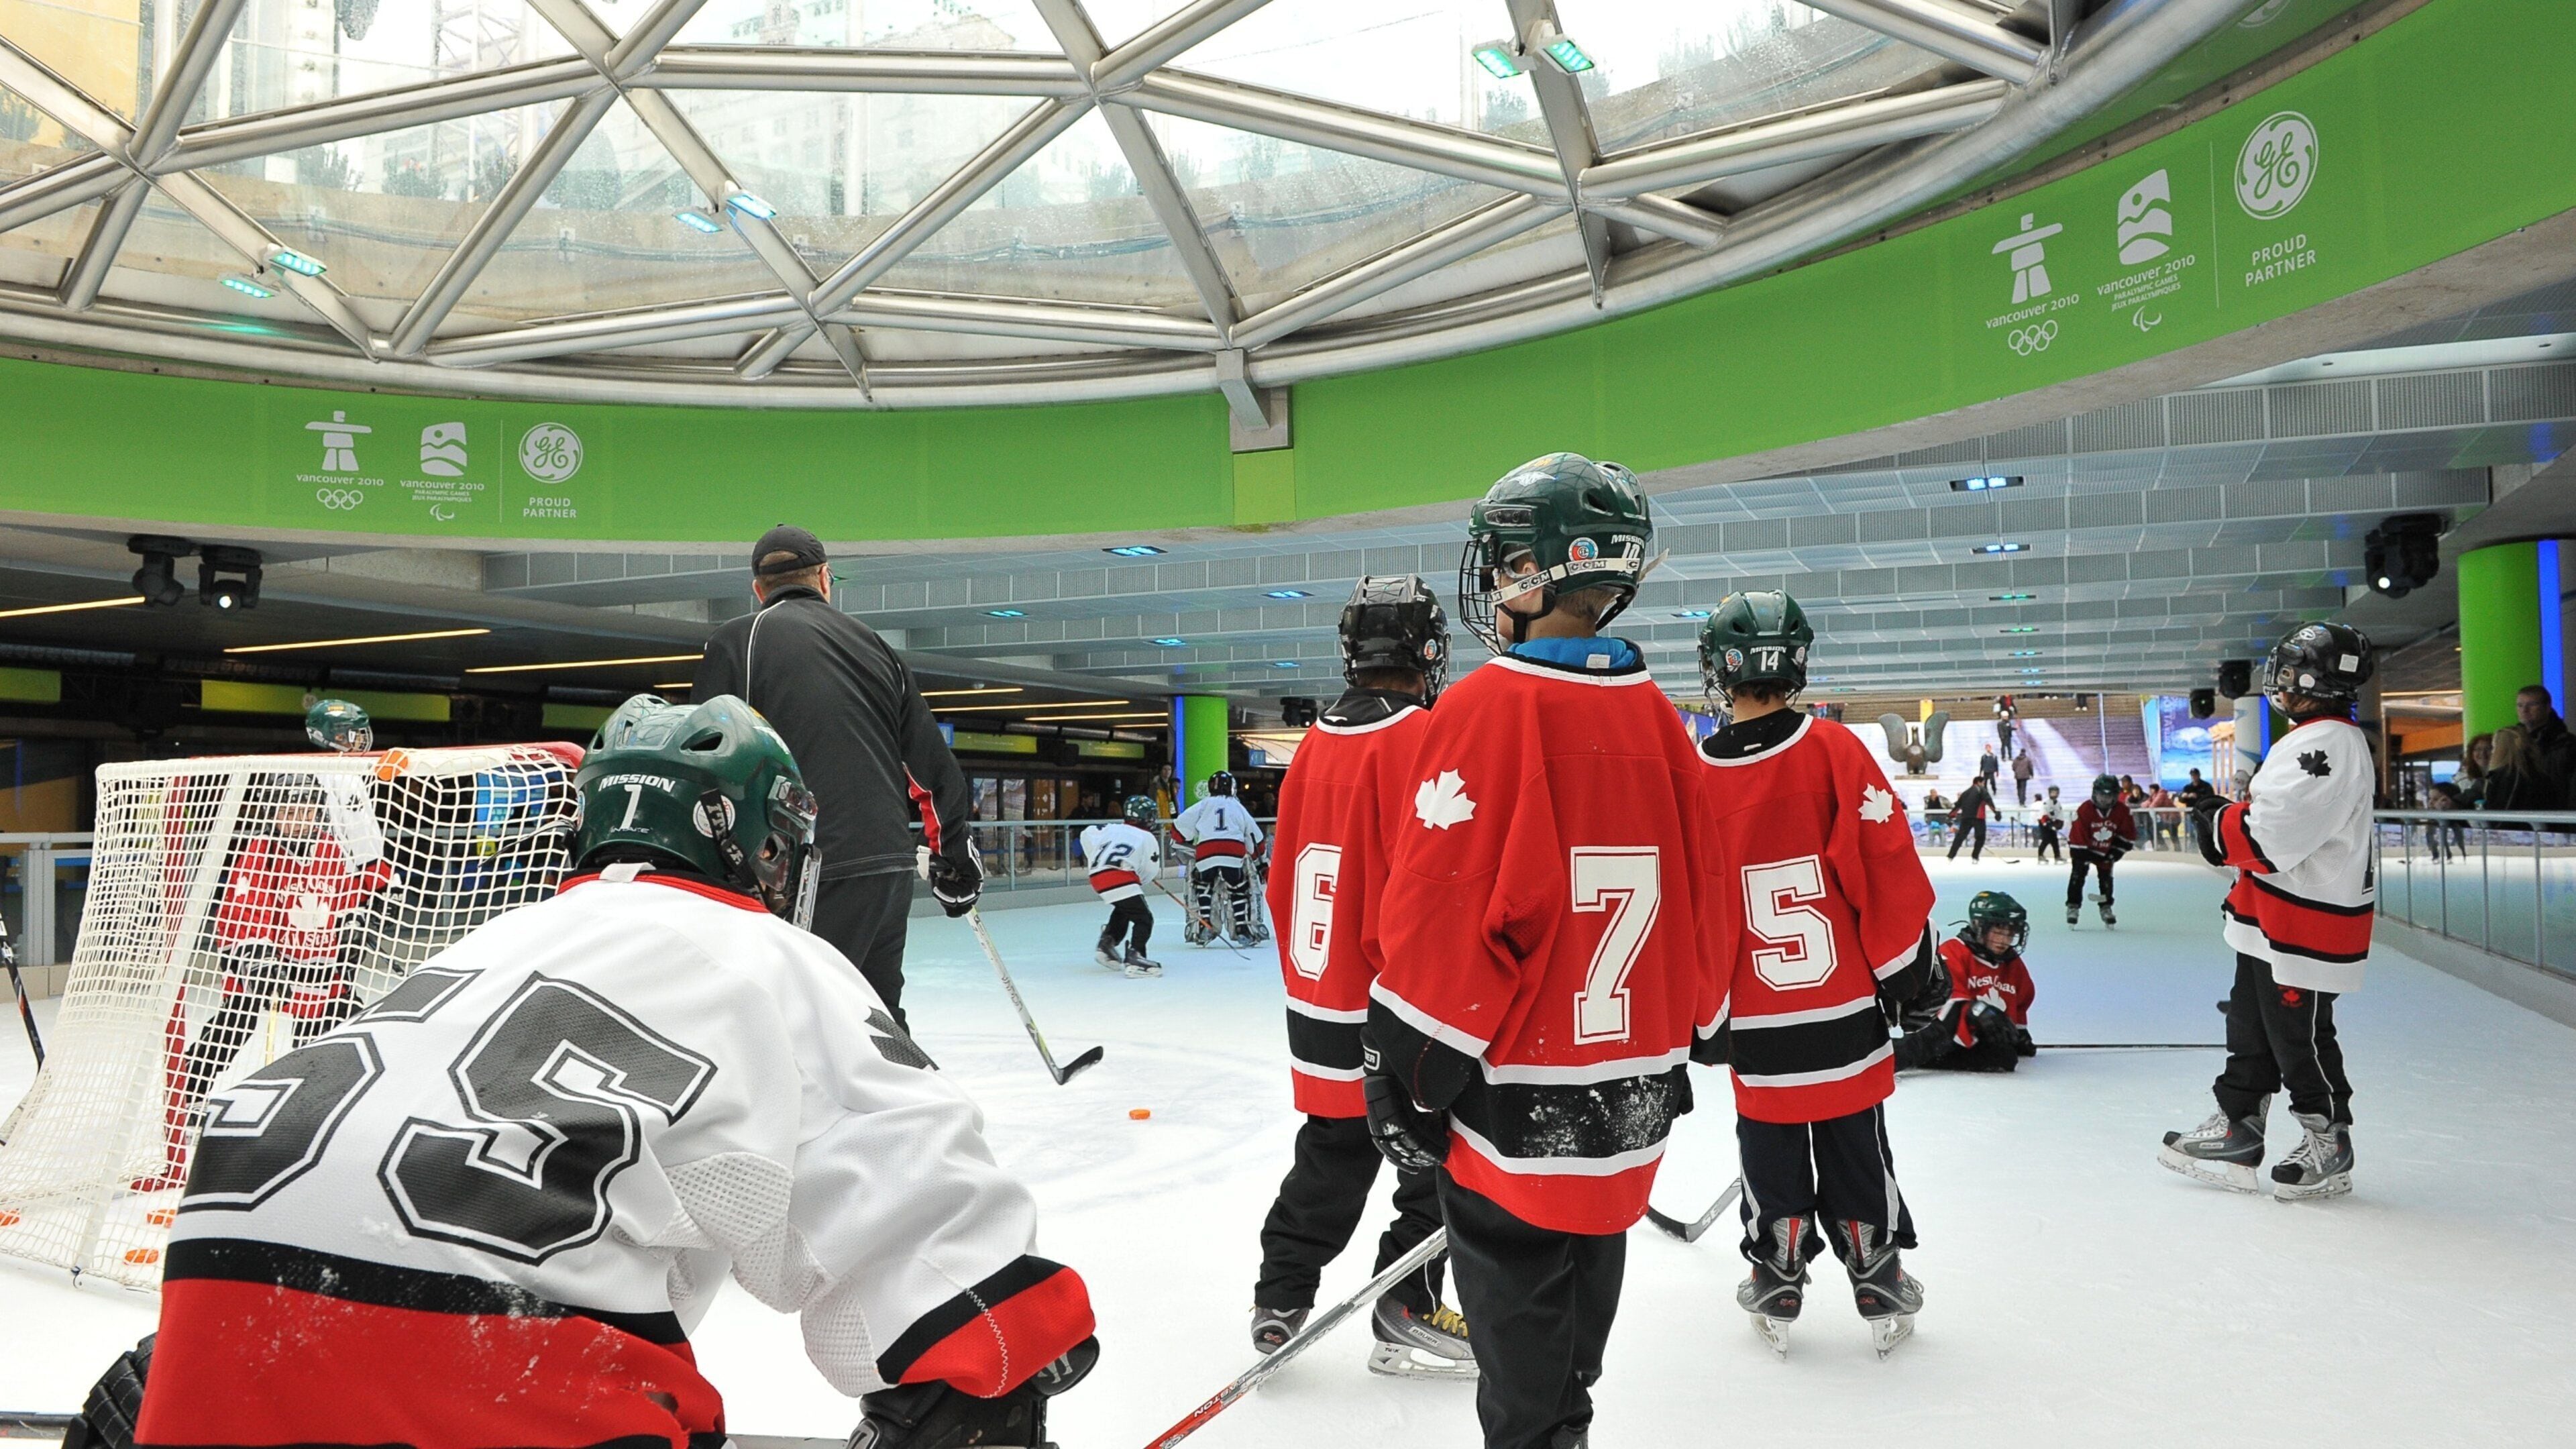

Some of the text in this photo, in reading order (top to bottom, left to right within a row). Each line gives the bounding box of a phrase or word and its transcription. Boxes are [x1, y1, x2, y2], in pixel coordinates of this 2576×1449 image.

[2251, 233, 2307, 266] PROUD
[2097, 254, 2196, 296] vancouver 2010
[2245, 250, 2316, 287] PARTNER
[2111, 282, 2182, 312] JEUX PARALYMPIQUES
[2113, 274, 2178, 301] PARALYMPIC GAMES
[1985, 294, 2080, 329] vancouver 2010
[296, 474, 384, 486] vancouver 2010
[400, 479, 485, 491] vancouver 2010
[523, 508, 577, 519] PARTNER
[529, 496, 572, 508] PROUD
[1569, 561, 1606, 572] CCM
[1519, 572, 1551, 591] CCM
[1750, 646, 1788, 655] MISSION
[1761, 651, 1779, 671] 14
[598, 773, 676, 793] MISSION
[620, 784, 641, 830] 1
[1214, 807, 1228, 832] 1
[1091, 840, 1135, 868] 12
[1289, 843, 1342, 981] 6
[1742, 854, 1838, 991] 5
[1570, 846, 1660, 1044] 7
[176, 968, 718, 1267] 55
